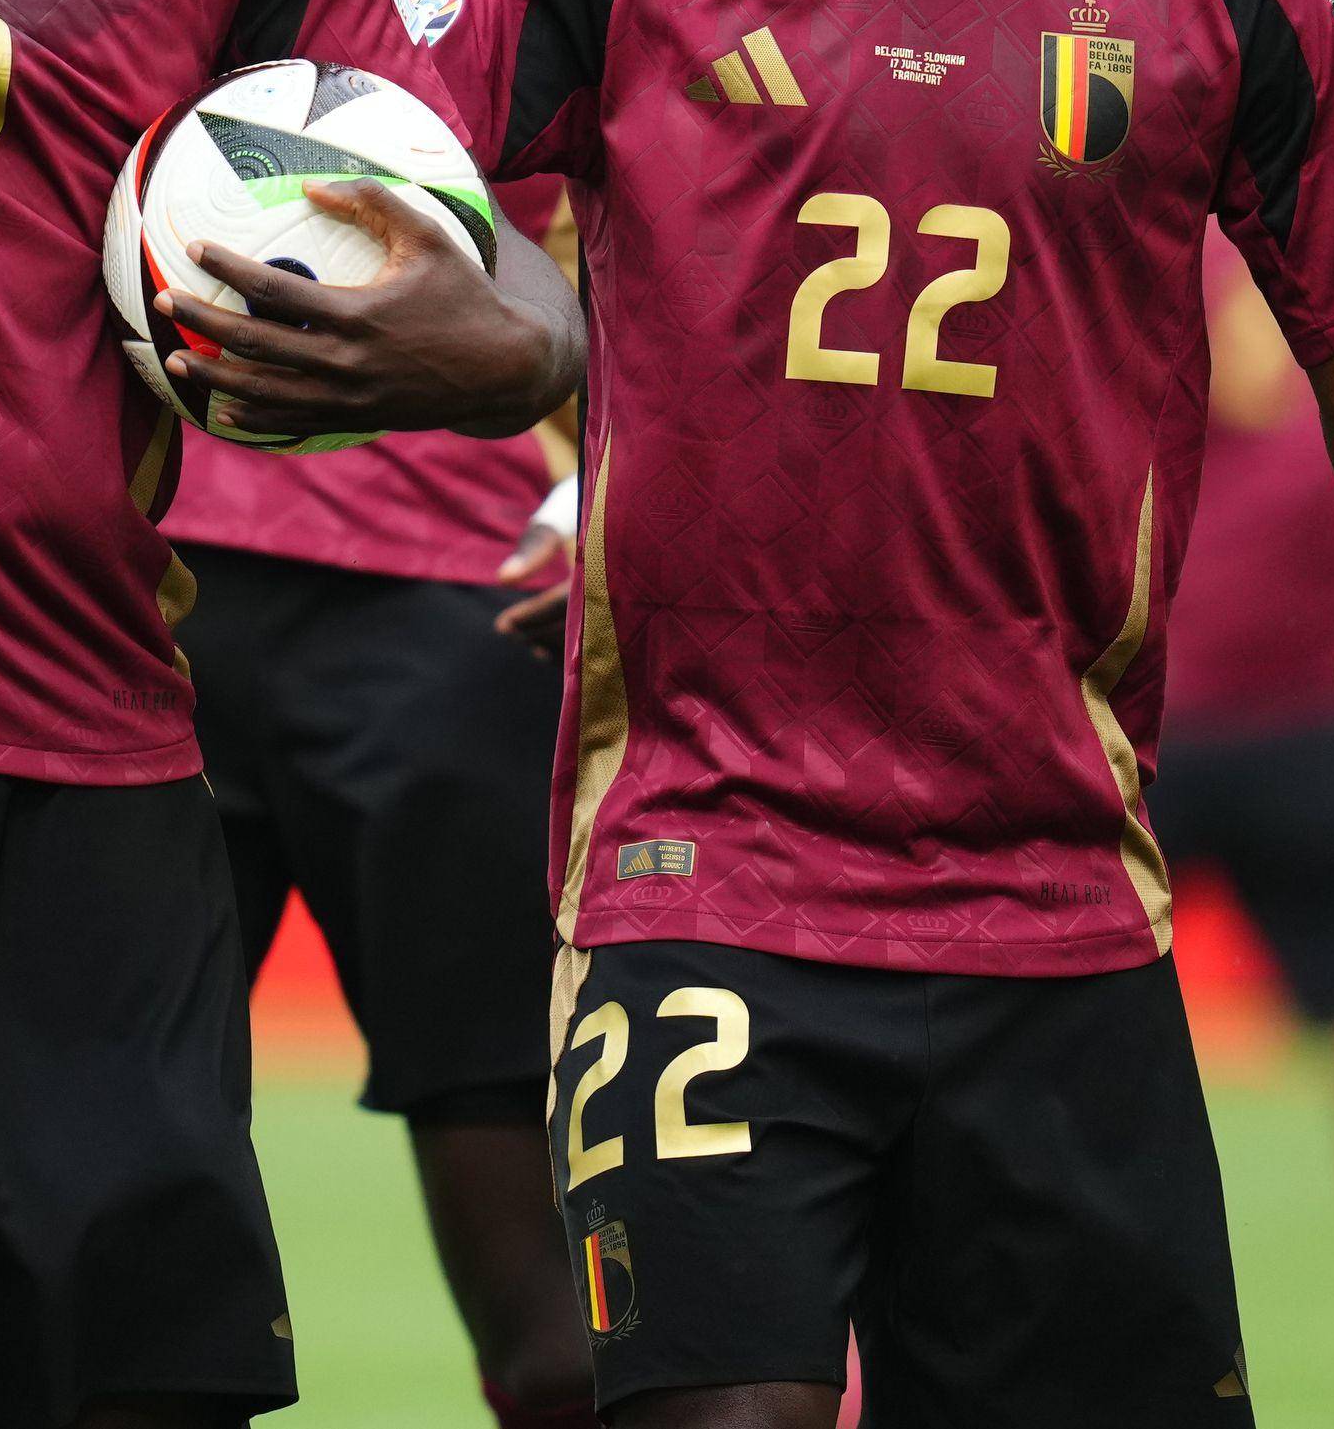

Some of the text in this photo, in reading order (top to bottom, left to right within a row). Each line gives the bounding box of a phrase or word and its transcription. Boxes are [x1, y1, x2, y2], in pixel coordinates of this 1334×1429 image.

[874, 45, 914, 59] BELGIUM
[924, 52, 966, 66] SLOVAKIA
[1089, 41, 1122, 52] ROYAL
[890, 58, 947, 75] 17 JUNE 2024
[1089, 51, 1132, 64] BELGIAN
[892, 69, 943, 86] FRANKFURT
[230, 150, 276, 173] FRANKFURT
[785, 192, 1011, 398] 22
[1040, 881, 1078, 905] HEAT
[567, 986, 753, 1192] 22
